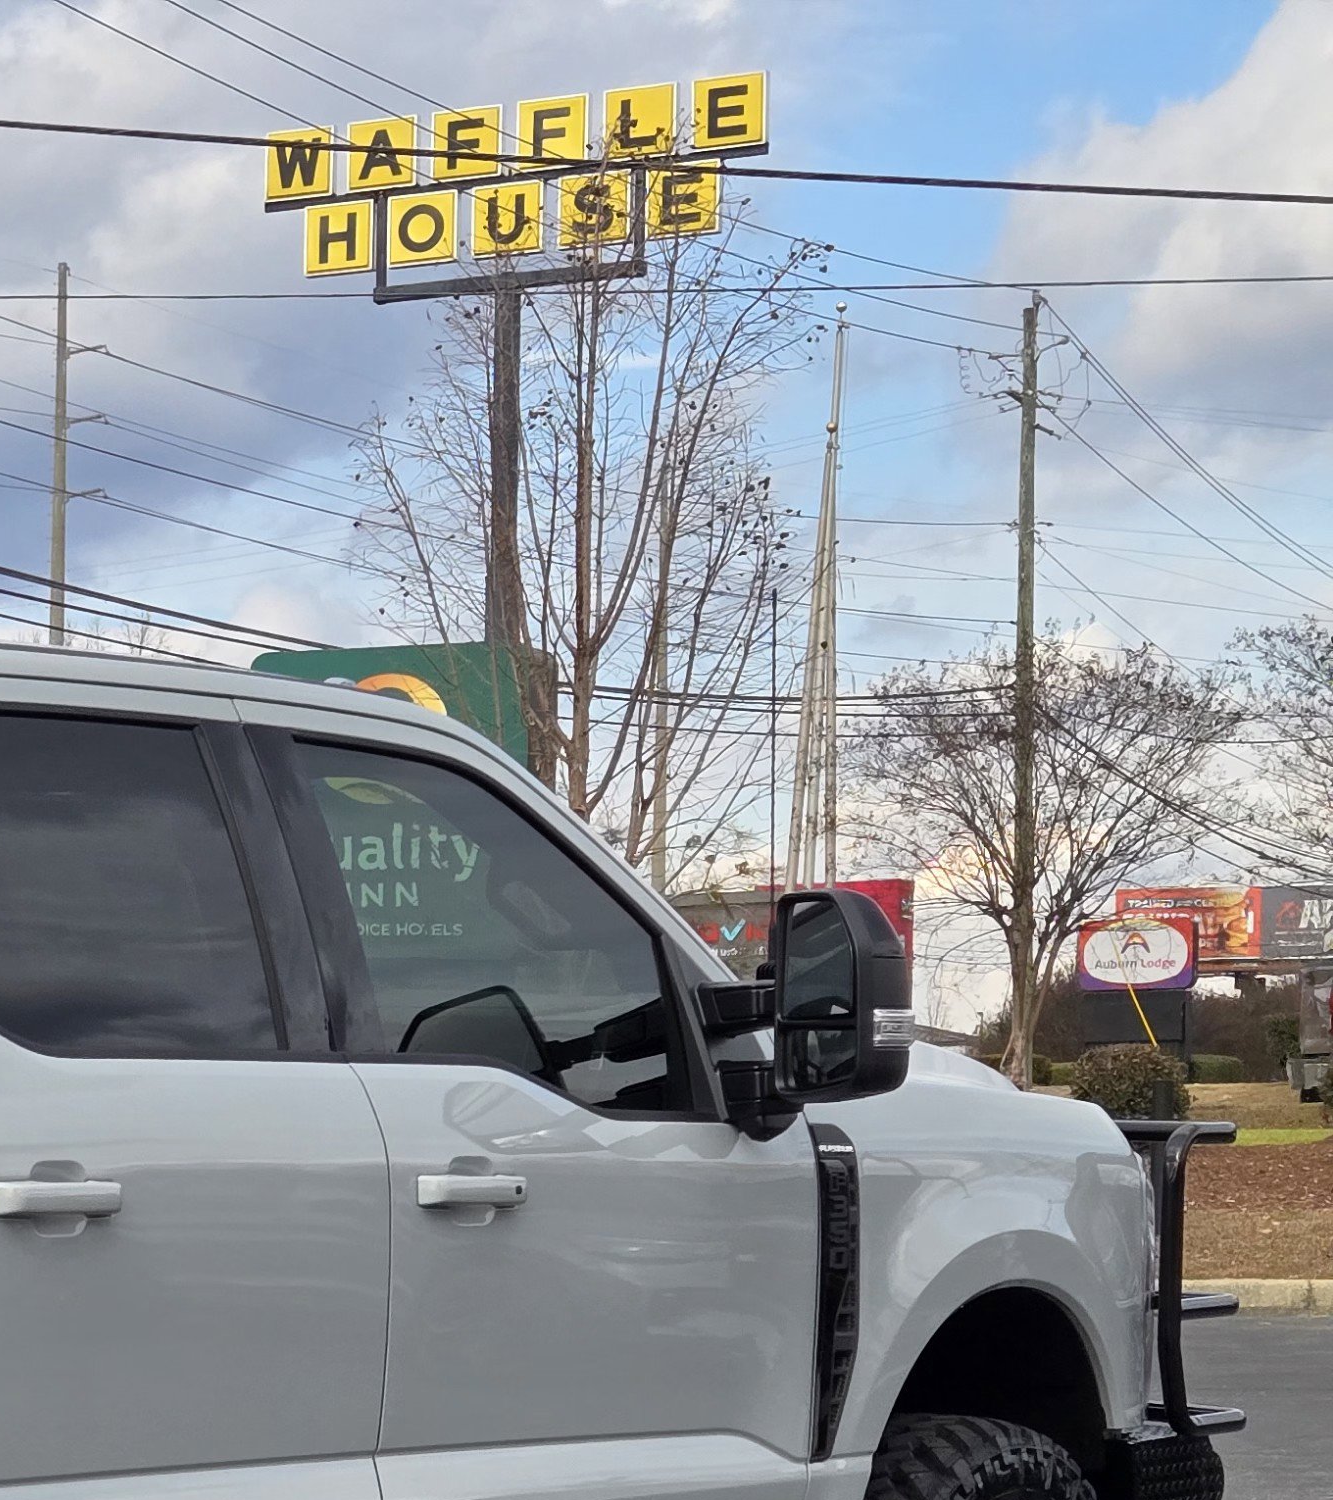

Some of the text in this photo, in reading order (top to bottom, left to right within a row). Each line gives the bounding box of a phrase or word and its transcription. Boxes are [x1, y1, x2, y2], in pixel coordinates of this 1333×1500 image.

[275, 84, 749, 189] WAFFLE
[318, 172, 702, 264] HOUSE
[339, 822, 481, 882] ality
[345, 881, 420, 907] INN
[357, 923, 391, 936] OICE
[1140, 958, 1177, 970] Lodge
